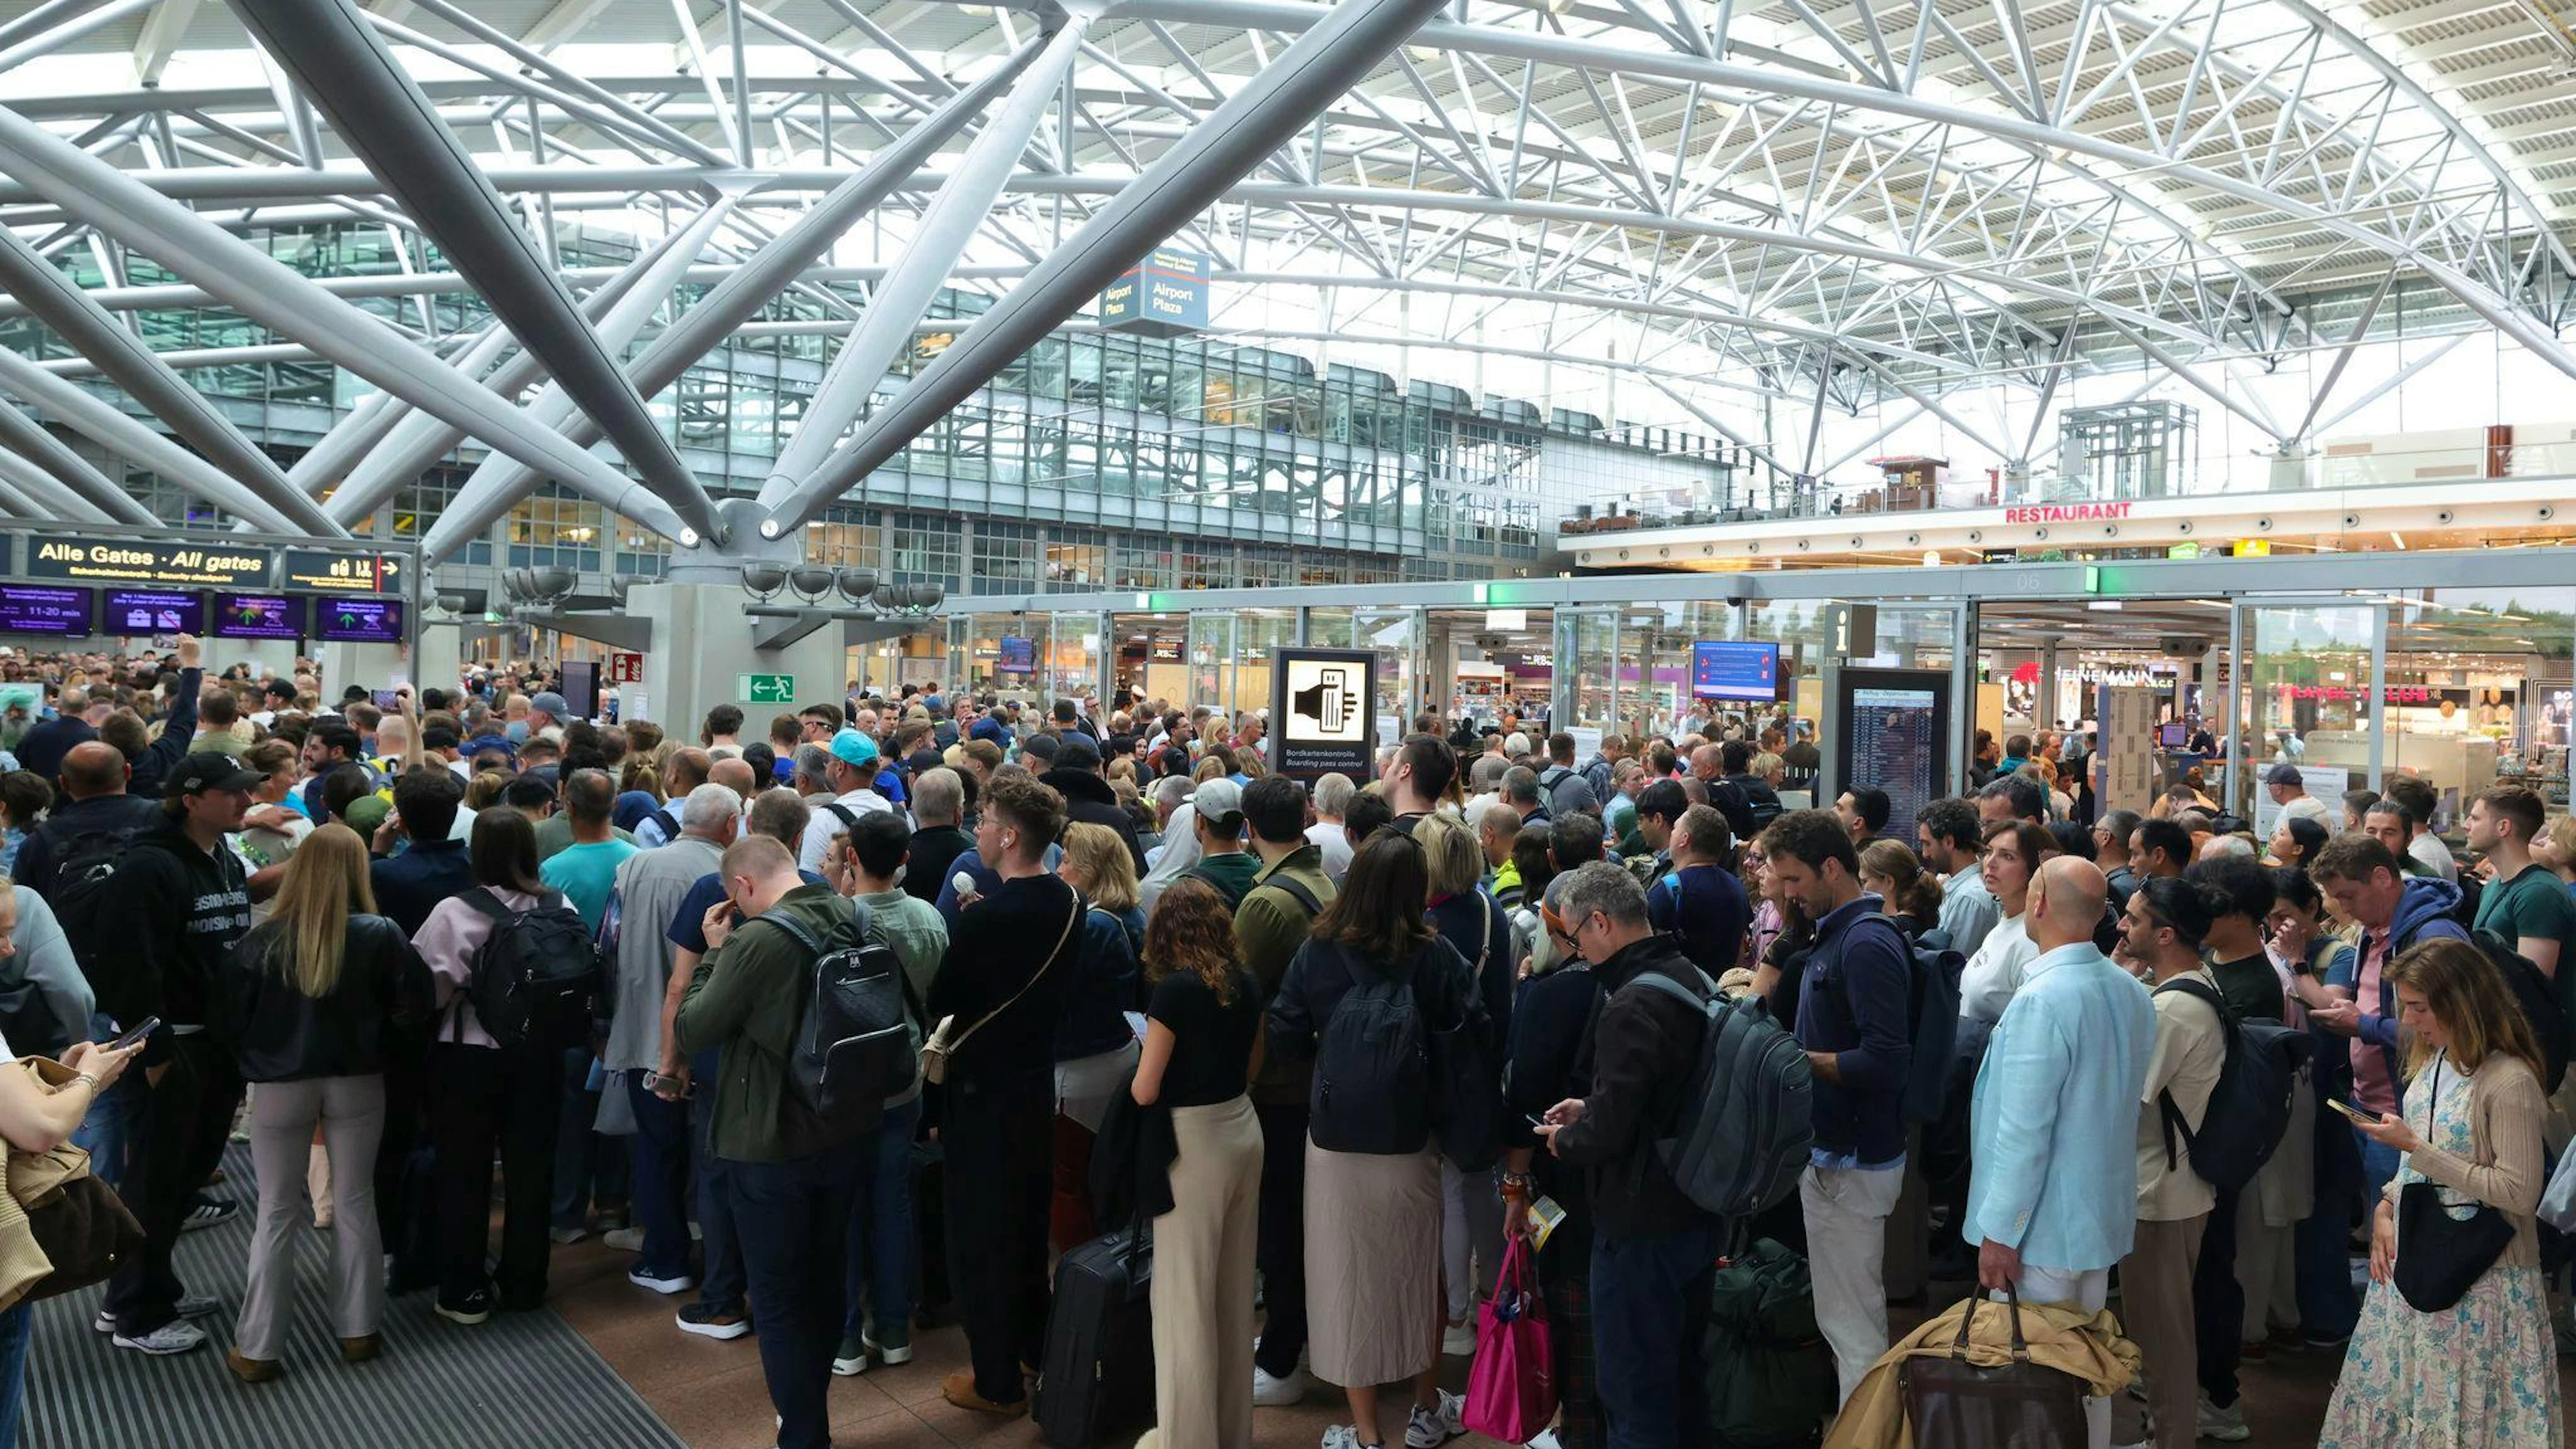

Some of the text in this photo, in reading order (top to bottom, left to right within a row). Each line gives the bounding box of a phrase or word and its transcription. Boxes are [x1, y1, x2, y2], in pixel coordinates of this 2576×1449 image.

[1106, 284, 1132, 301] Airport
[1153, 282, 1193, 301] Airport
[1106, 303, 1124, 315] Plaza
[1153, 297, 1182, 315] Plaza
[2006, 502, 2132, 523] RESTAURANT
[38, 543, 262, 572] Alle Gates All gates
[29, 606, 60, 616] 11-20
[2055, 666, 2153, 683] HEINEMANN
[2278, 686, 2352, 700] TRAVEL
[2360, 688, 2429, 702] VLUE
[1286, 749, 1356, 758] Bordkartenkontrolle
[1286, 759, 1319, 767] Boarding
